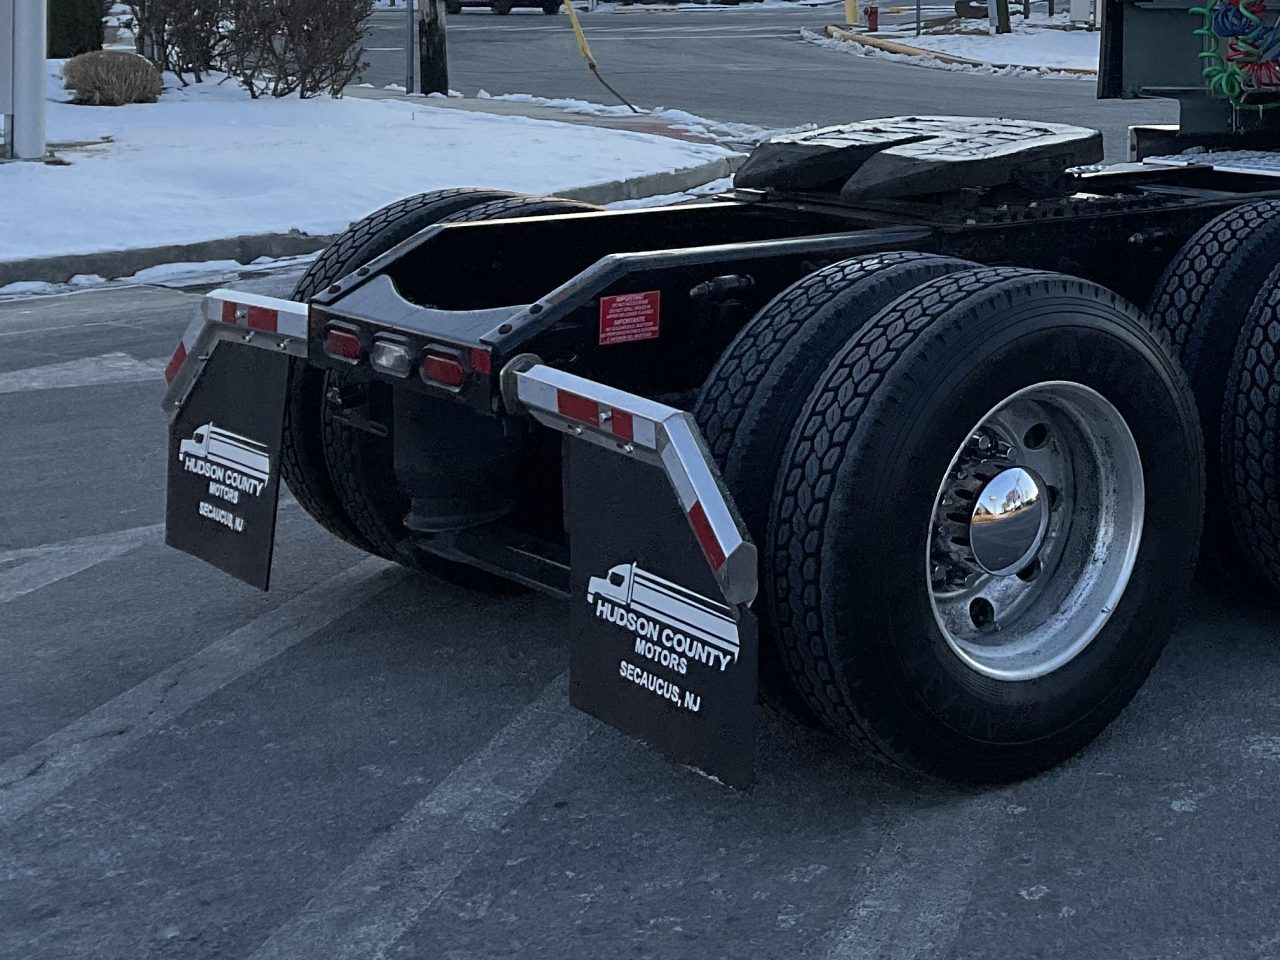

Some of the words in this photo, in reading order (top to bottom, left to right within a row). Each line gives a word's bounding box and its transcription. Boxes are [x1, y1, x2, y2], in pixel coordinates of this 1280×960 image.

[184, 457, 224, 482] HUDSON
[225, 470, 264, 497] COUNTY
[209, 481, 238, 504] MOTORS
[234, 516, 244, 532] NJ
[596, 599, 660, 641] HUDSON
[662, 628, 732, 671] COUNTY
[634, 637, 688, 675] MOTORS
[619, 660, 682, 707] SECAUCUS,
[684, 690, 701, 712] NJ
